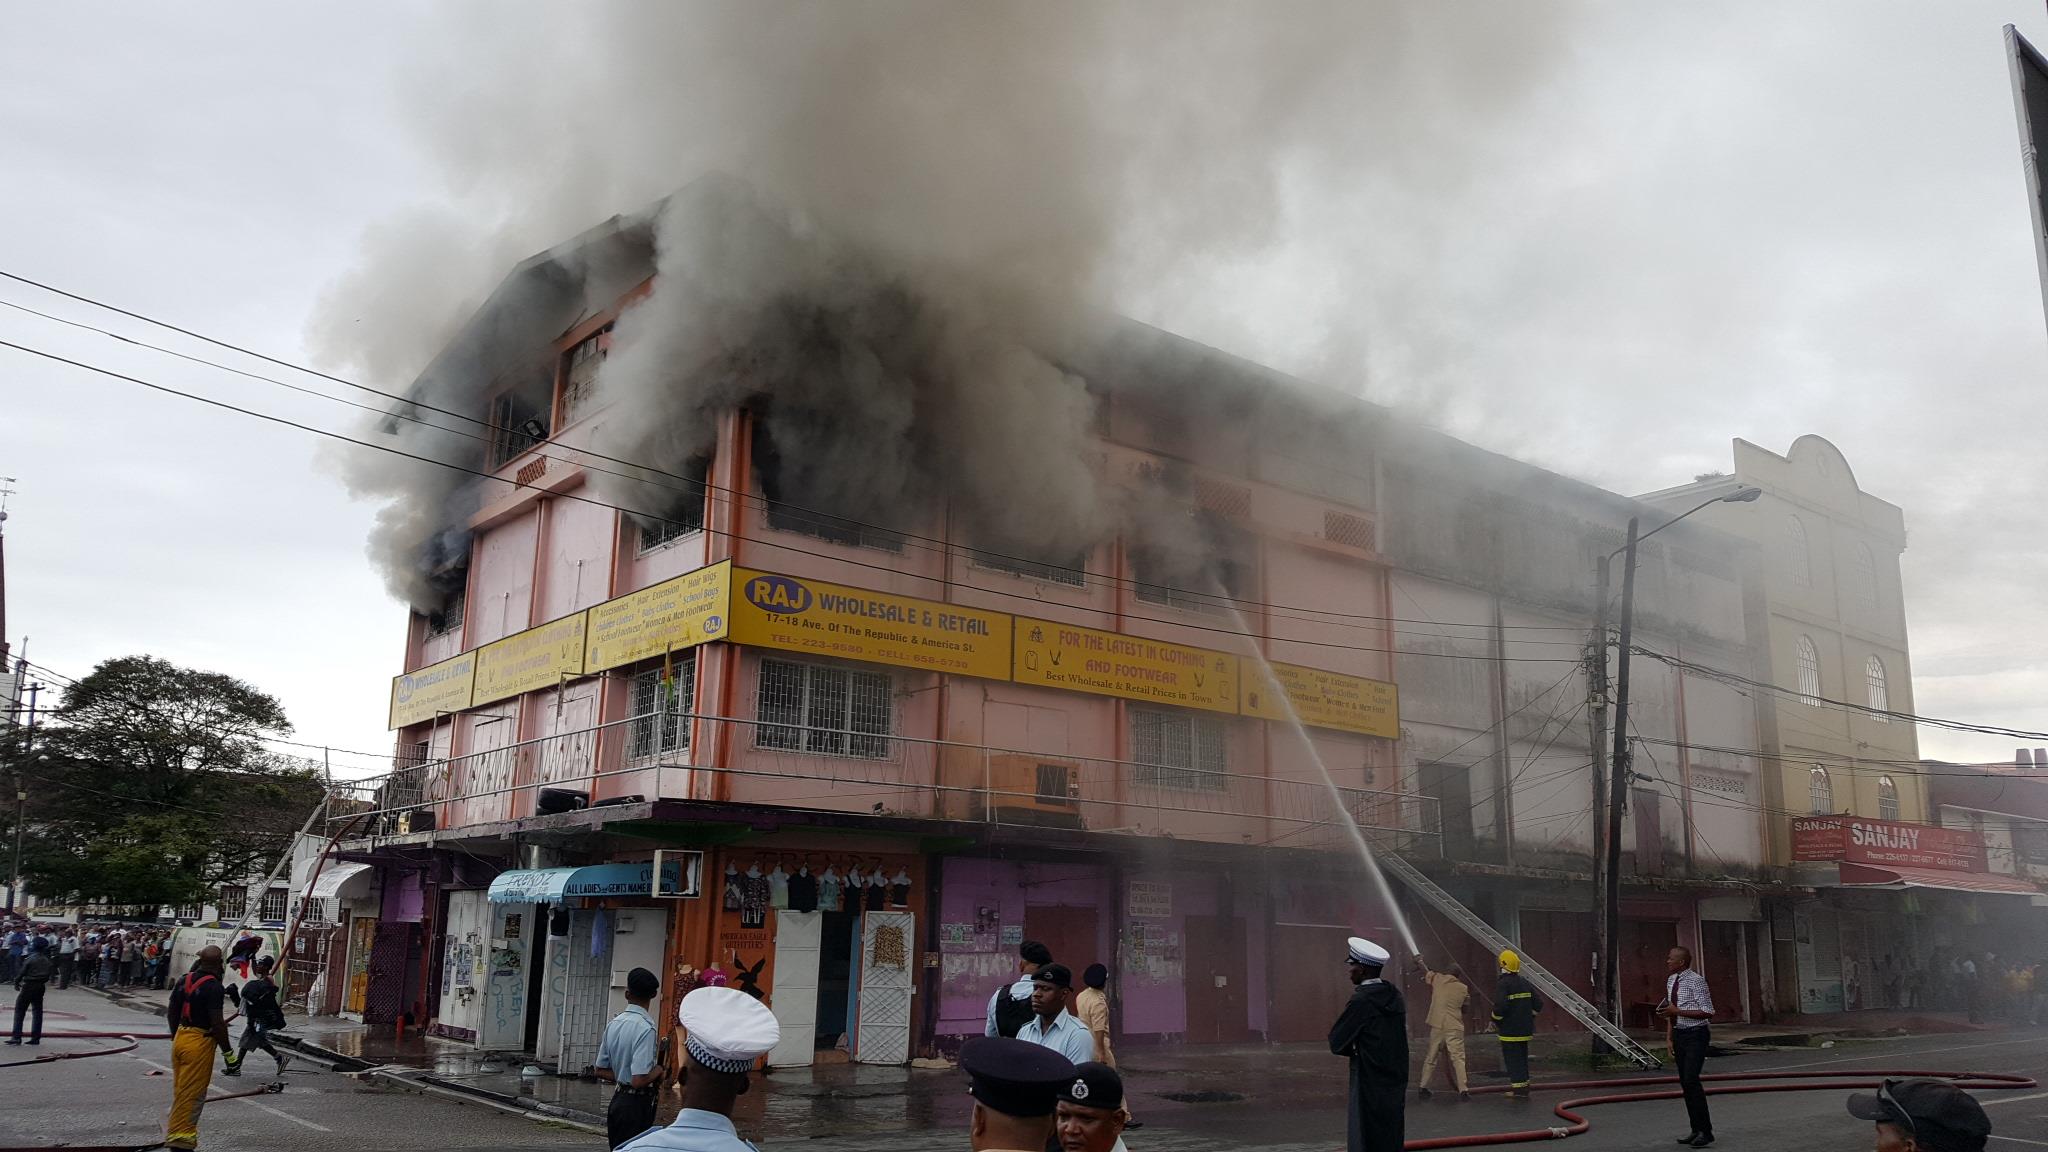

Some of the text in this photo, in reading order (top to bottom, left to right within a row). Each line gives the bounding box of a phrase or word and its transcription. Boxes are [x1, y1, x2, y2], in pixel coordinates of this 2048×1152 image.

[687, 577, 702, 589] Hair
[685, 601, 714, 617] Footwear
[753, 580, 989, 636] RAJ WHOLESALE & RETAIL
[705, 618, 721, 632] RAJ
[765, 613, 799, 626] 17-18
[801, 619, 825, 631] Ave.
[828, 622, 840, 633] Of
[843, 624, 861, 636] The
[864, 628, 907, 643] Republic
[911, 635, 919, 645] &
[921, 637, 960, 651] America
[1059, 630, 1205, 668] FOR THE LATEST IN CLOTHING
[1086, 659, 1177, 685] AND FOOTWEAR
[1046, 670, 1212, 703] Best Wholesale & Retail Prices in Town
[1794, 820, 1842, 831] SANJAY
[1852, 822, 1920, 850] SANJAY
[566, 883, 578, 895] ALL
[580, 883, 600, 894] LADIES
[608, 883, 627, 893] GENTS
